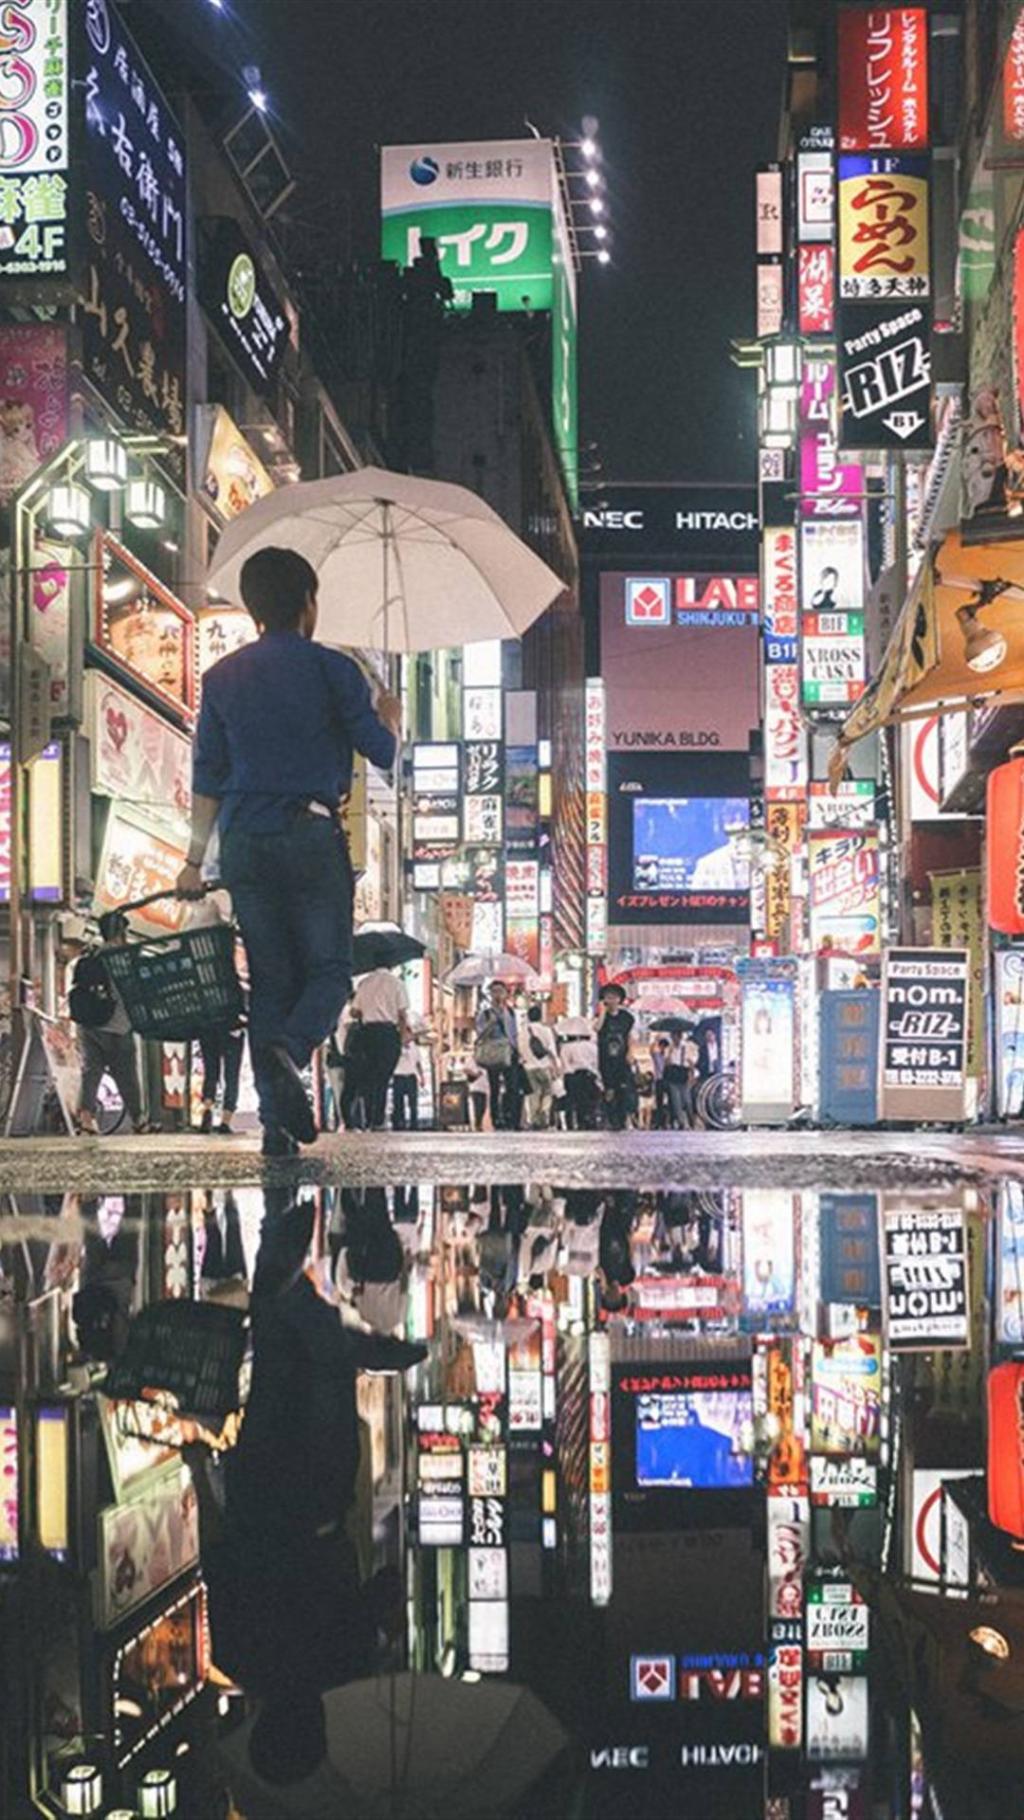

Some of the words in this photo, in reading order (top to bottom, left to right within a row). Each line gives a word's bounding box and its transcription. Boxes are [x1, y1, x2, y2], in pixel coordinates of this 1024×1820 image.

[867, 13, 893, 148] リフレッシュ
[446, 158, 523, 180] 新生銀行
[871, 158, 899, 173] 1F
[851, 179, 917, 273] らーめん
[14, 224, 64, 259] 4F
[843, 277, 926, 297] 博多天神
[844, 328, 882, 355] Party
[879, 308, 922, 338] Space
[846, 340, 928, 415] RIZ
[893, 415, 914, 427] B1
[584, 511, 643, 529] NEC
[677, 612, 745, 625] SHINJUKU
[806, 648, 861, 663] XROSS
[812, 664, 855, 679] CASA
[612, 731, 674, 746] YUNIKA
[679, 731, 721, 746] BLDG
[893, 963, 922, 976] Party
[925, 963, 961, 976] Space
[901, 1012, 949, 1035] RIZ
